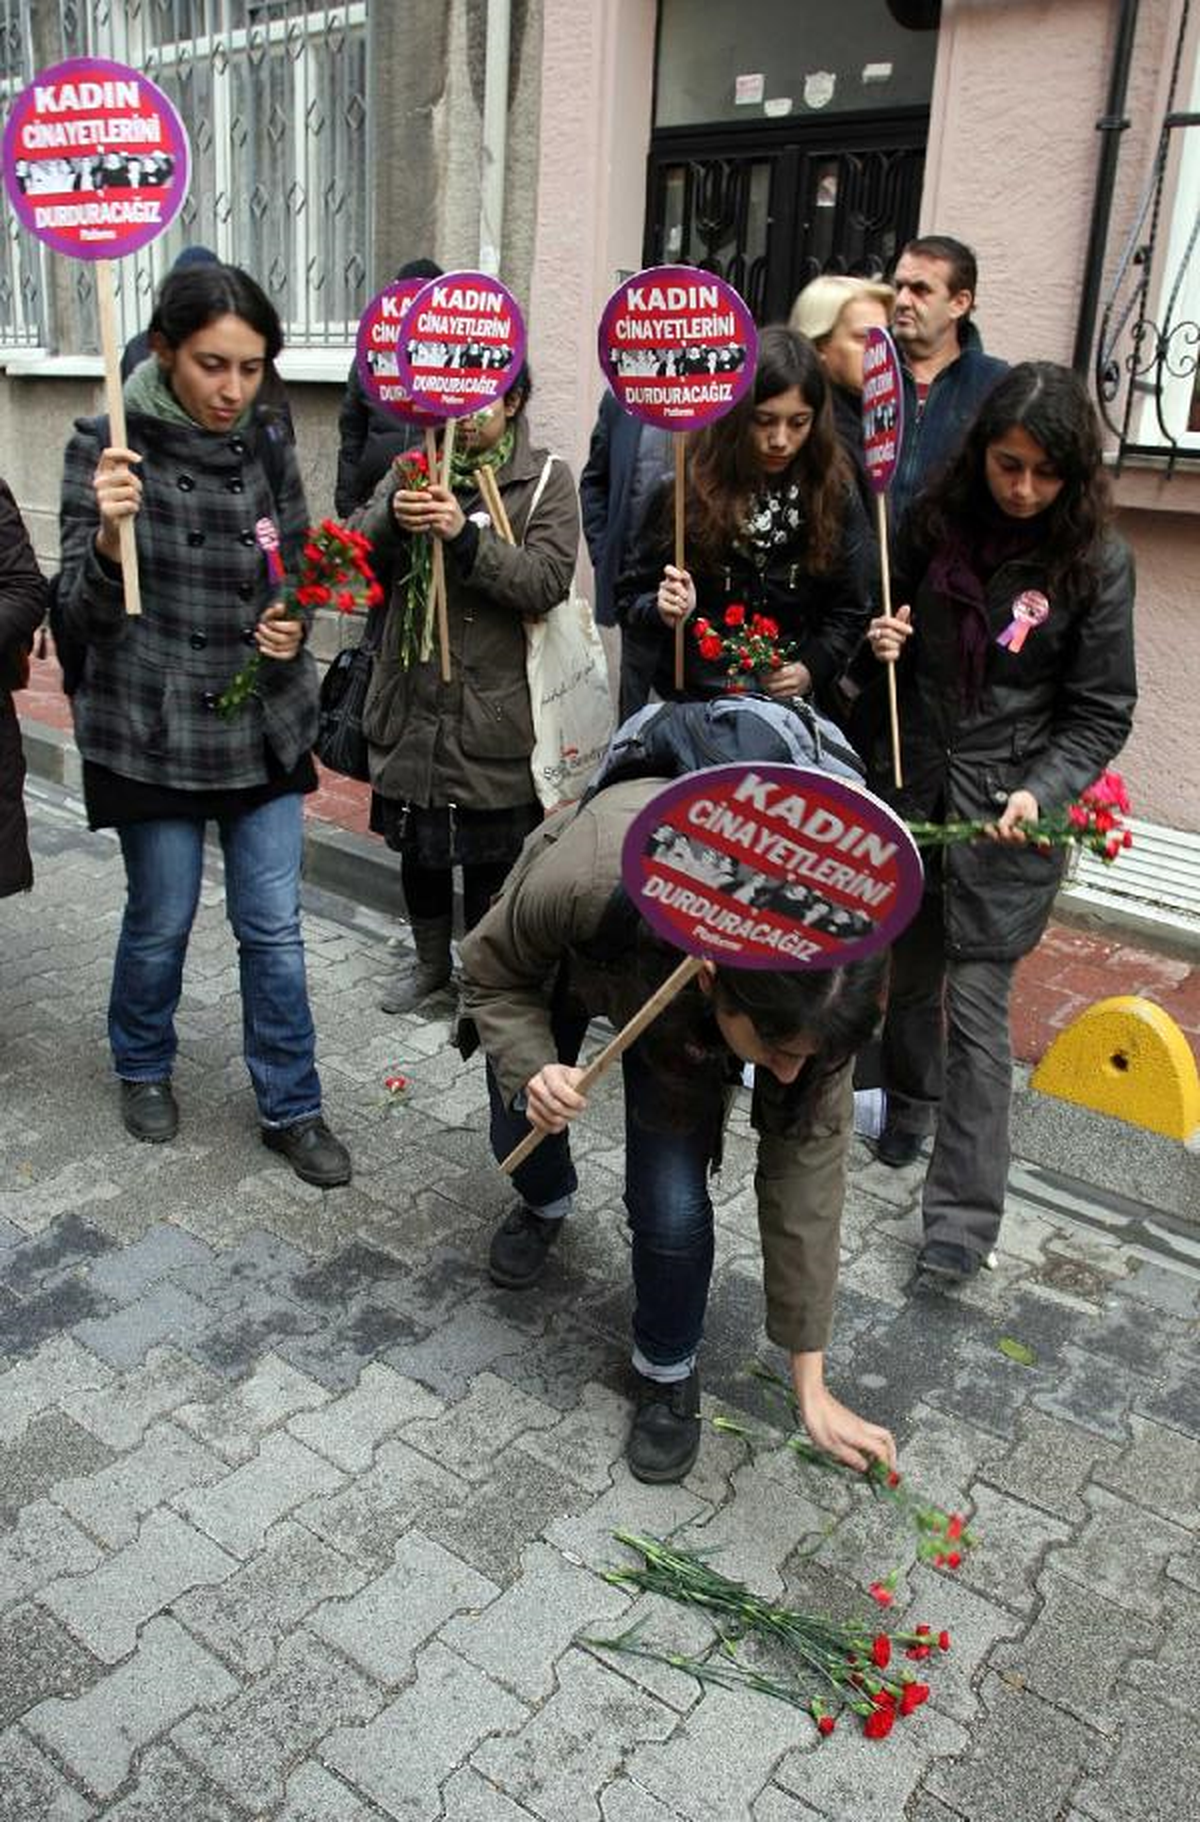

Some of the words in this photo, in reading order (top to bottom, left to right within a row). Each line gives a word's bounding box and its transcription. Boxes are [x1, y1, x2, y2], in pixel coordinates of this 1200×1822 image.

[35, 82, 139, 112] KADIN
[22, 114, 160, 148] CİNAYETLERİNİ
[34, 197, 162, 228] DURDURACAĞIZ
[431, 287, 503, 313] KADIN
[627, 286, 718, 311] KADIN
[417, 311, 511, 339] CİNAYETLERİNİ
[615, 311, 735, 340] CİNAYETLERİNİ
[625, 381, 732, 404] DURDURACAĞIZ
[734, 774, 897, 867] KADIN
[688, 800, 894, 905] CİNAYETLERİNİ
[643, 877, 821, 961] DURDURACAĞIZ
